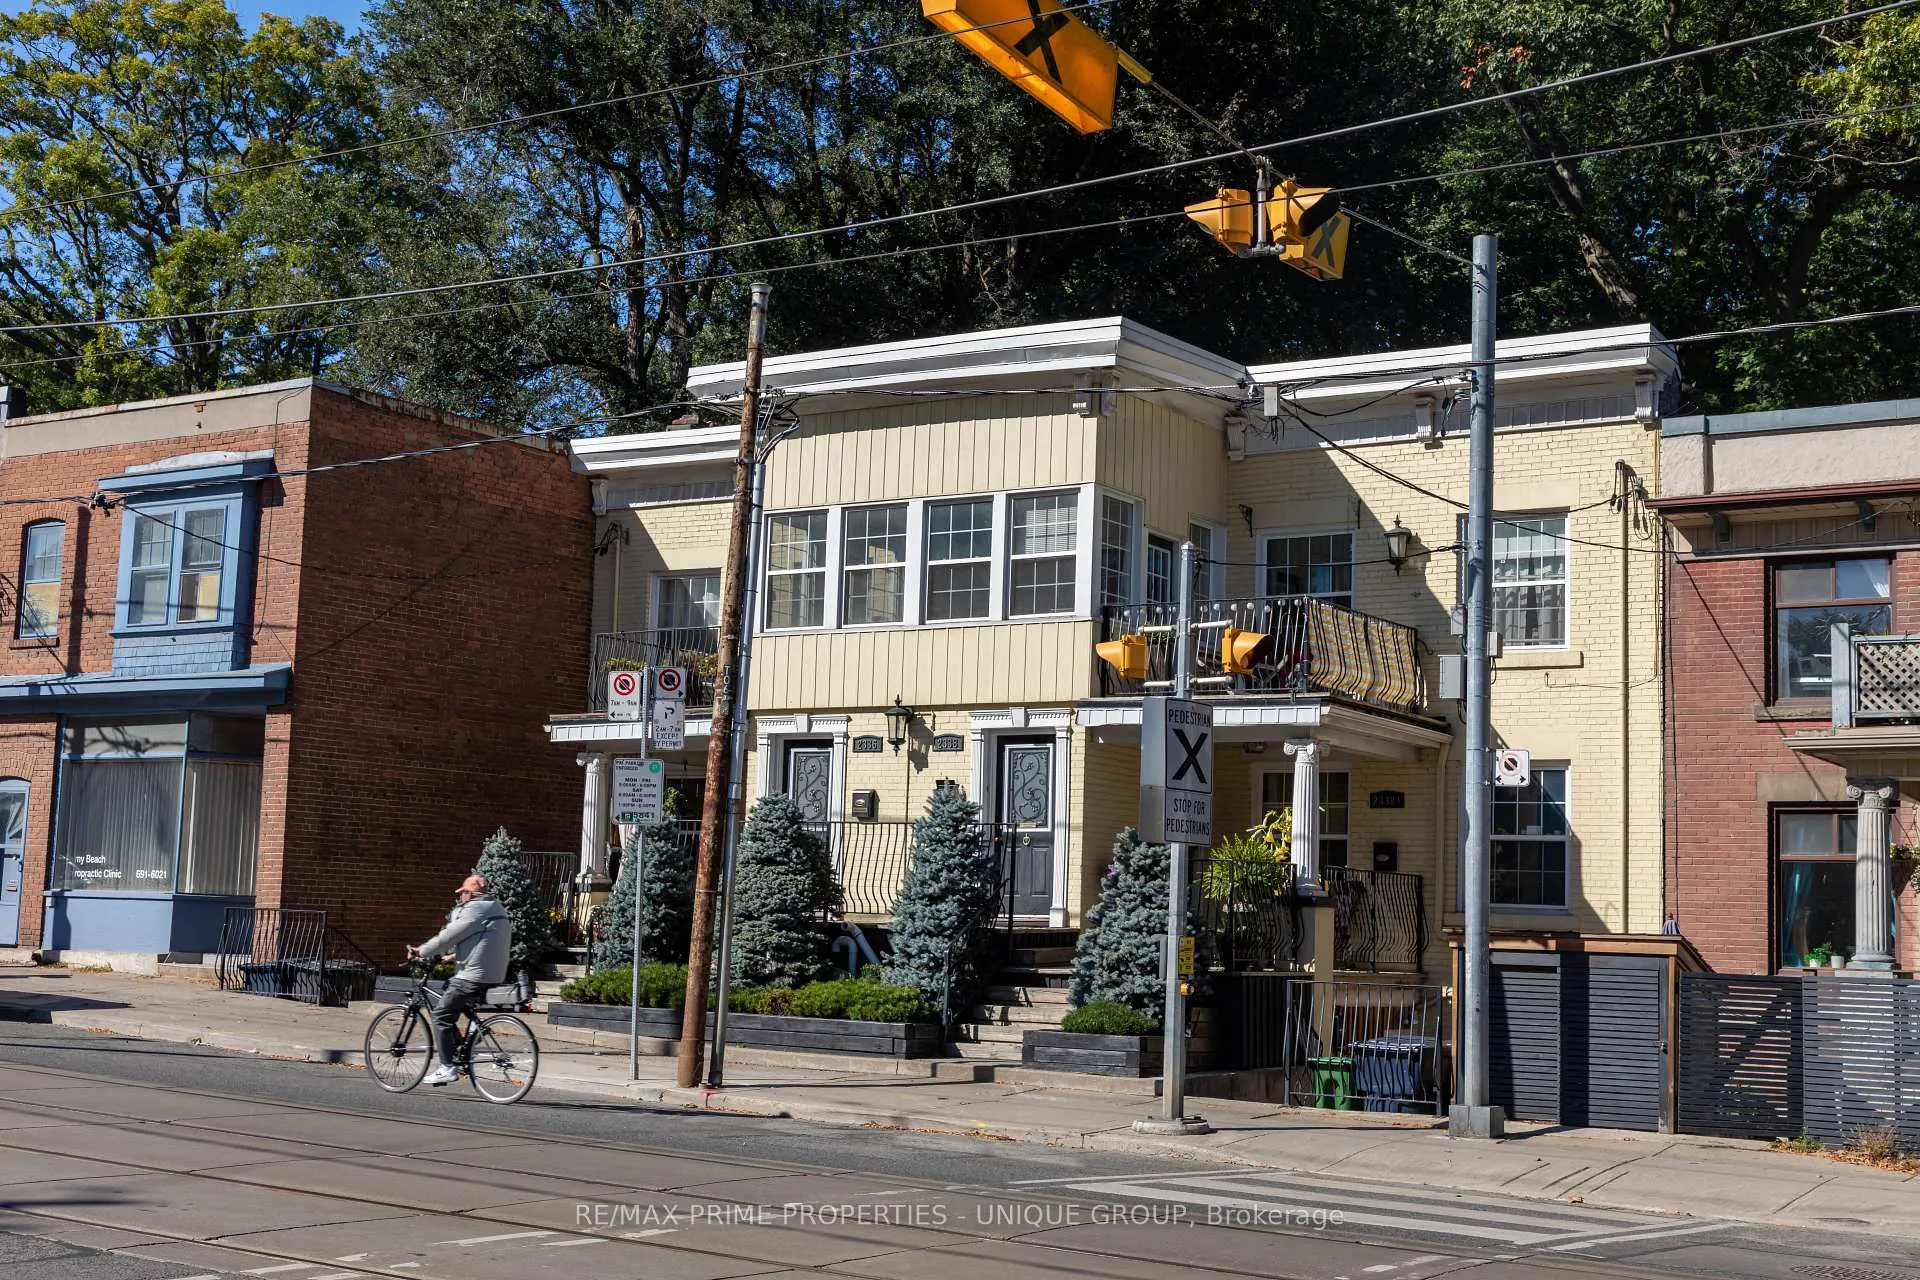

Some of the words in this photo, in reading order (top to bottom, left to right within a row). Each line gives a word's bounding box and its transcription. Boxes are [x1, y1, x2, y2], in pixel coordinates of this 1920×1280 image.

[1168, 708, 1210, 728] PEDESTRIAN
[656, 732, 679, 740] EXCEPT
[1173, 798, 1191, 813] STOP
[1193, 799, 1205, 815] FOR
[1166, 818, 1210, 836] PEDESTRIANS
[86, 854, 106, 864] Beach
[74, 868, 102, 880] ropractic
[103, 869, 122, 878] Clinic
[135, 869, 167, 879] 691-6021
